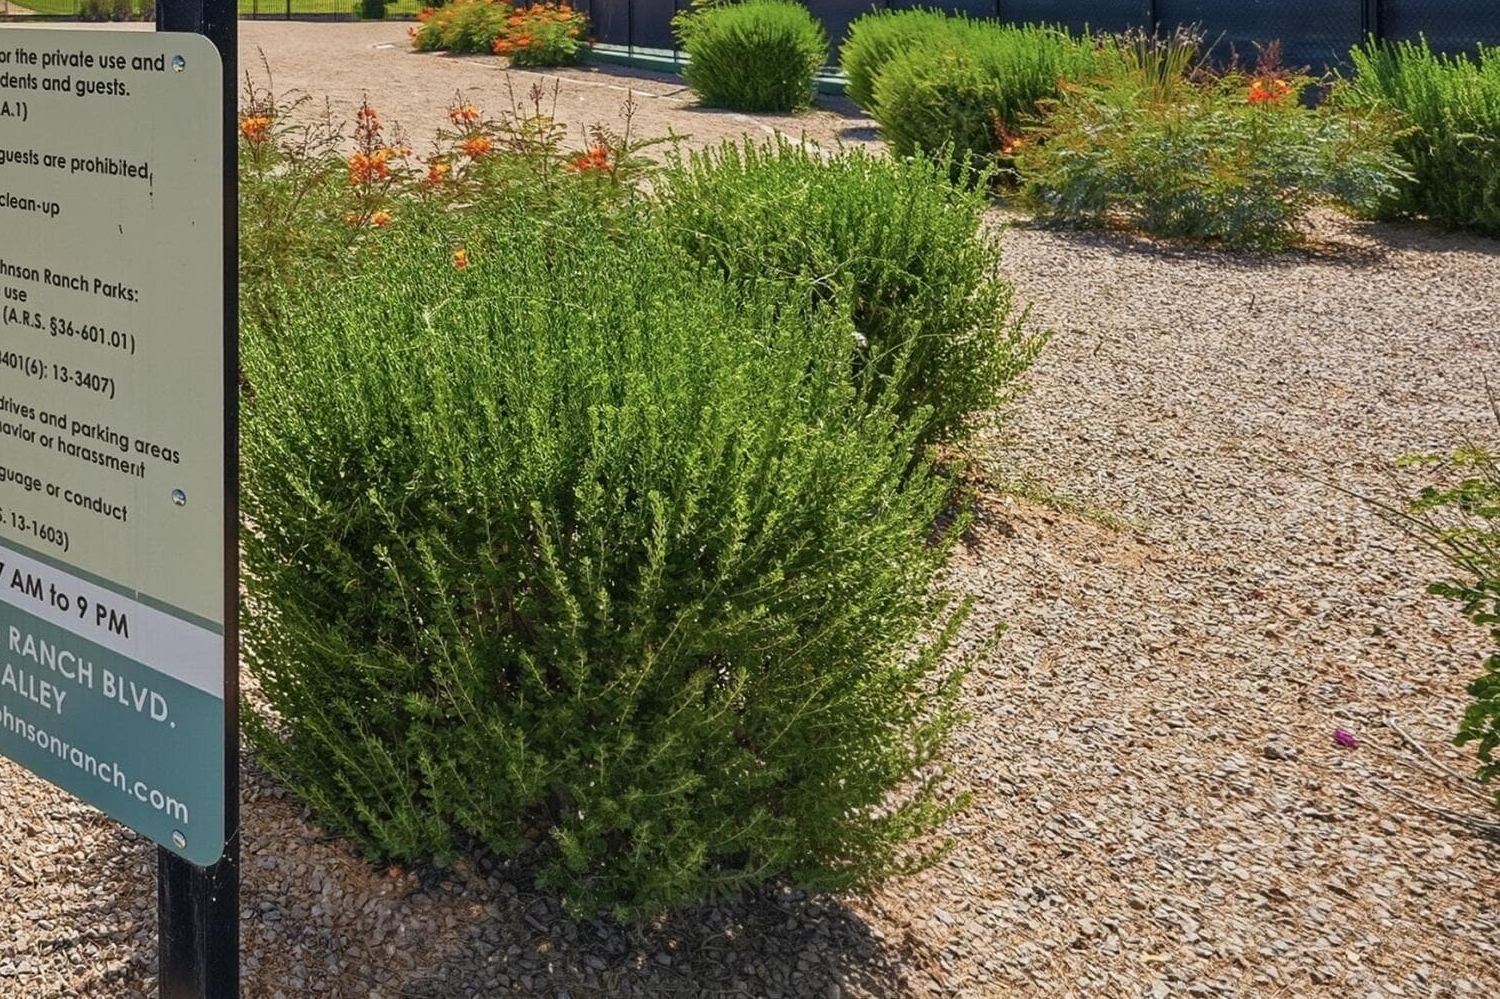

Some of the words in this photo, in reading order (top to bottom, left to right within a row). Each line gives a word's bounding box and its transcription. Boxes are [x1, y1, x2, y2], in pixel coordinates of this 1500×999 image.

[15, 46, 38, 66] the
[42, 48, 95, 70] private
[99, 54, 127, 70] use
[131, 52, 165, 72] and
[41, 74, 71, 93] and
[75, 77, 131, 98] guests.
[43, 153, 67, 170] are
[4, 285, 28, 303] use
[44, 267, 89, 293] Ranch
[93, 276, 139, 303] Parks:
[53, 363, 115, 400] 13-3407)
[39, 410, 67, 431] and
[71, 419, 129, 453] parking
[134, 438, 180, 465] areas
[39, 433, 54, 449] or
[57, 434, 146, 479] harassment
[46, 482, 61, 498] or
[64, 488, 128, 523] conduct
[11, 511, 70, 554] 13-1603)
[10, 568, 43, 601] AM
[49, 583, 69, 611] to
[76, 595, 87, 618] 9
[96, 602, 128, 638] PM
[9, 625, 92, 688] RANCH
[103, 669, 175, 728] BLVD.
